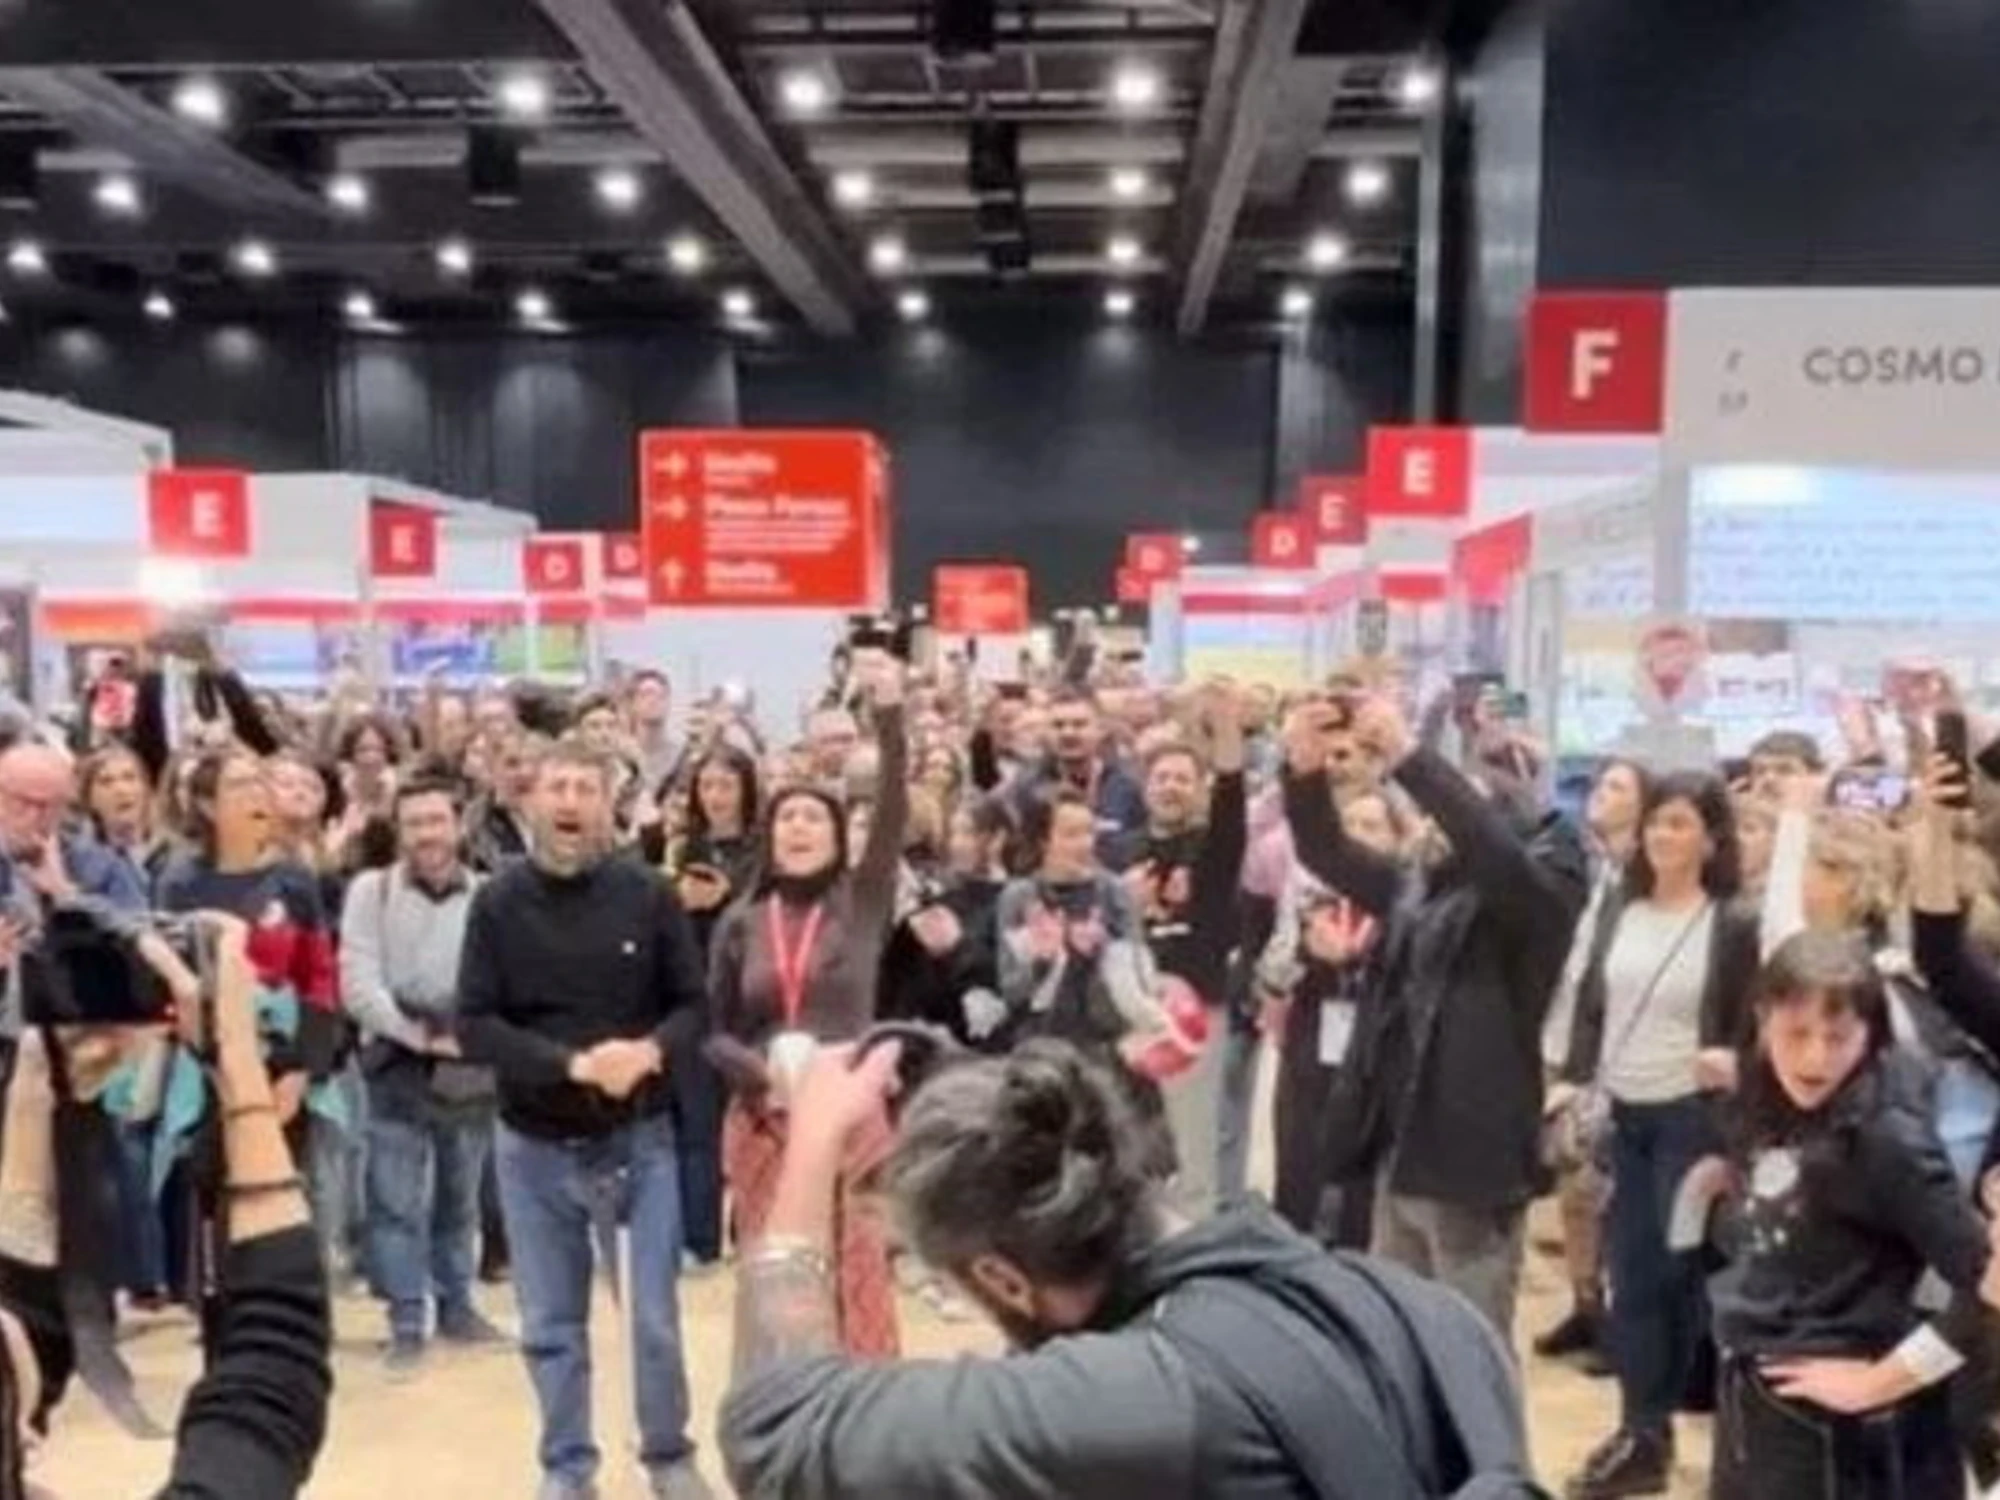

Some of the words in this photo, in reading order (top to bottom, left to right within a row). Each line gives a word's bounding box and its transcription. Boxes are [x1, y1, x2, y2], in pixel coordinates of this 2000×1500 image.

[1572, 329, 1619, 399] F
[1802, 346, 1985, 385] COSMO
[1405, 449, 1436, 495] E
[191, 490, 226, 538] E
[1320, 493, 1348, 530] E
[390, 524, 418, 563] E
[1270, 526, 1297, 556] D
[543, 551, 571, 582] D
